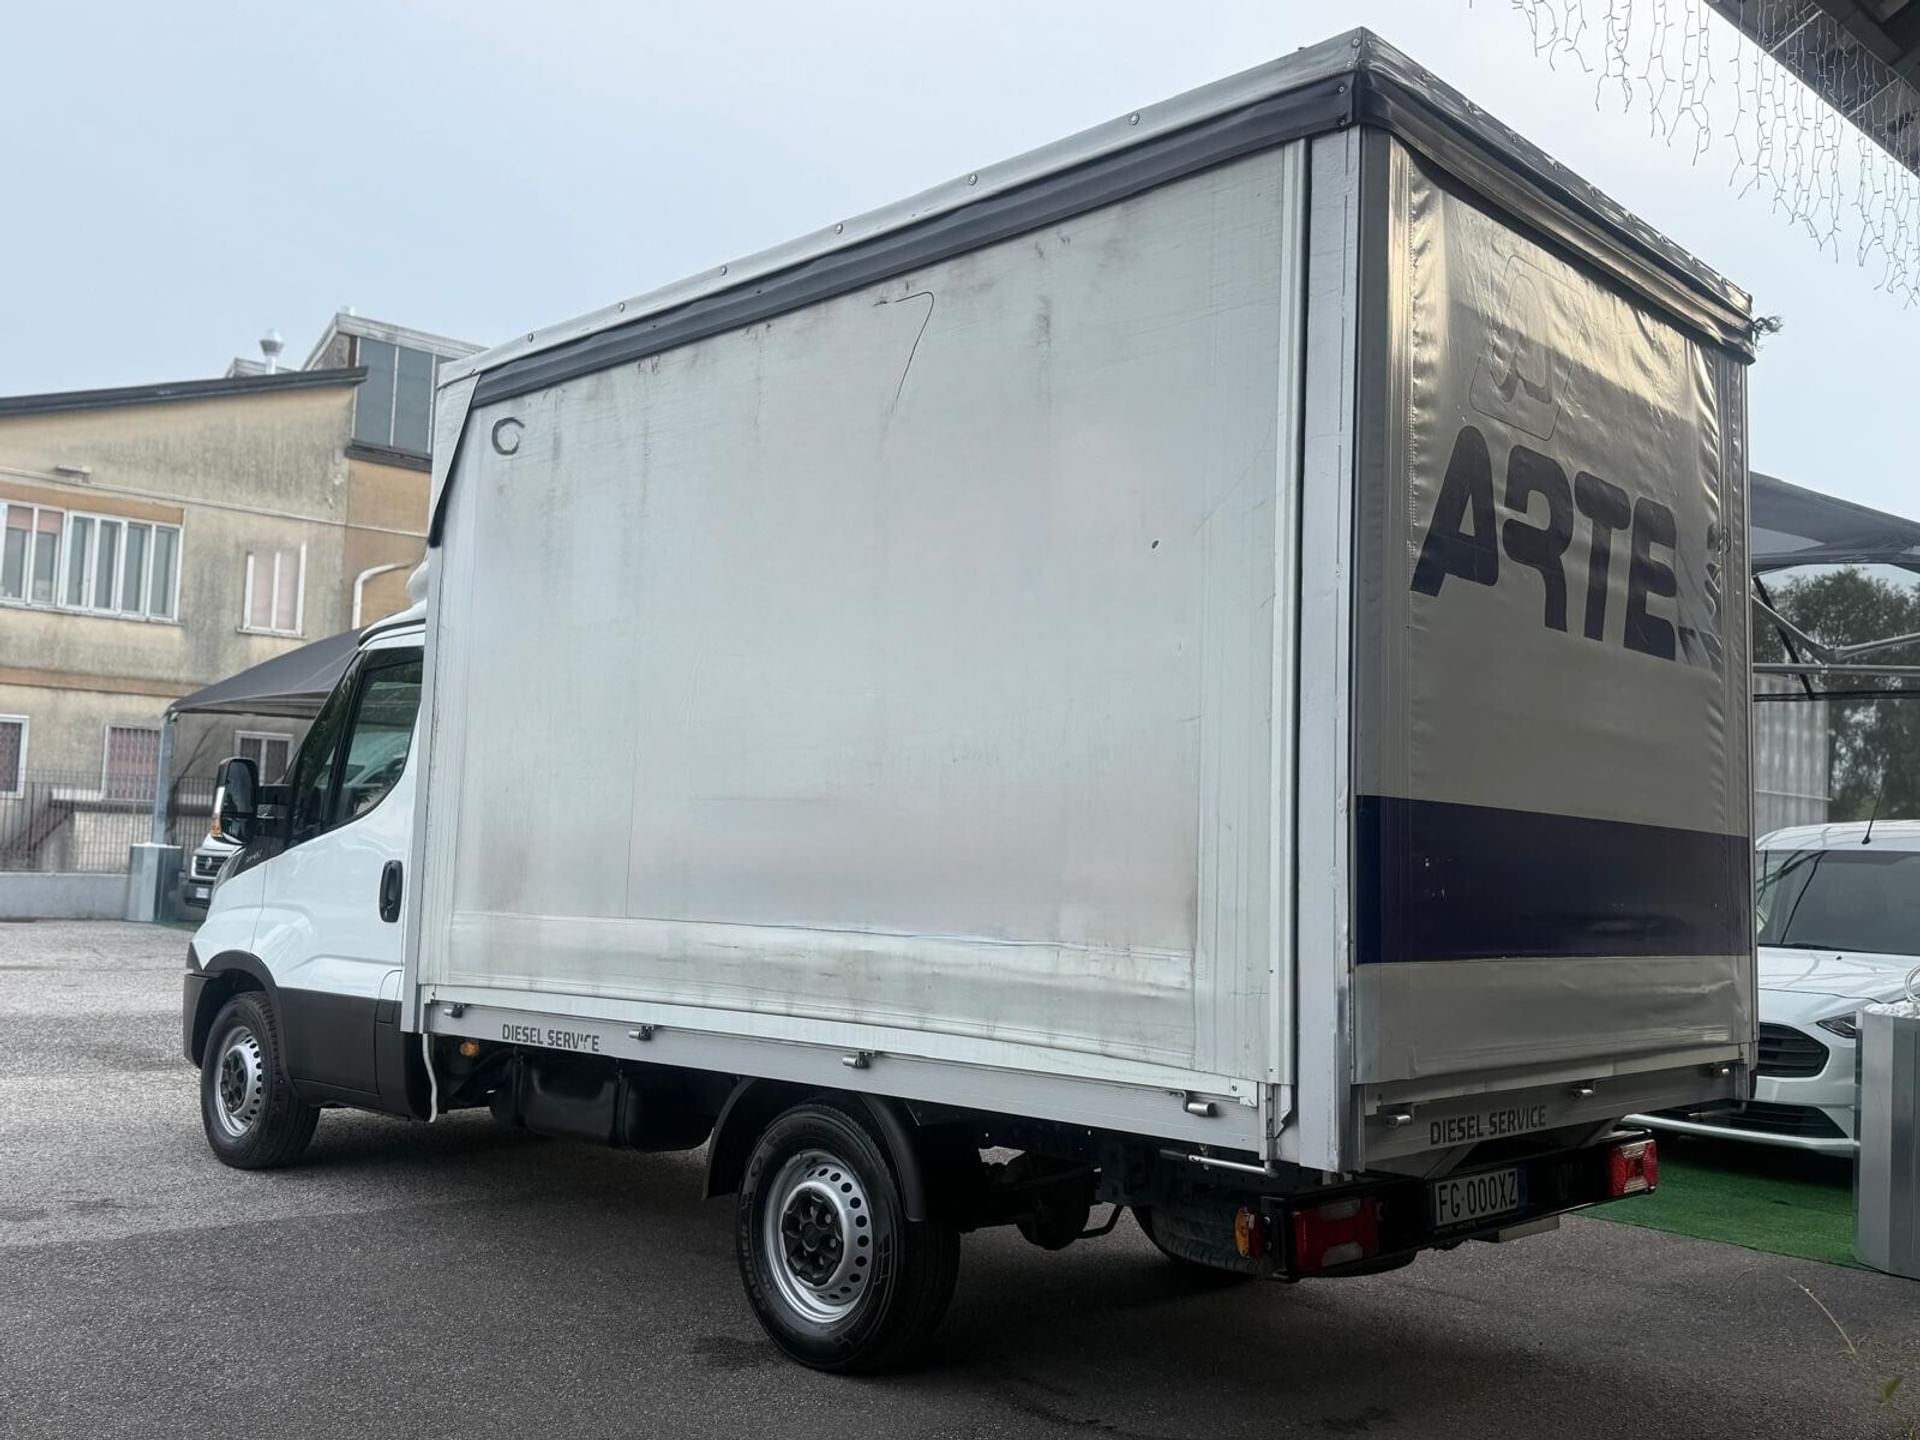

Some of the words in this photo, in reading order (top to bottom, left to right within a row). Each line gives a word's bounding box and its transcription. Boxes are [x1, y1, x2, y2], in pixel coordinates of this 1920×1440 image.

[1410, 425, 1720, 669] ARTE
[502, 1023, 544, 1045] DIESEL
[1430, 1114, 1484, 1145] DIESEL
[1489, 1104, 1547, 1135] SERVICE
[1438, 1183, 1460, 1222] FG
[1467, 1172, 1516, 1215] 000XZ
